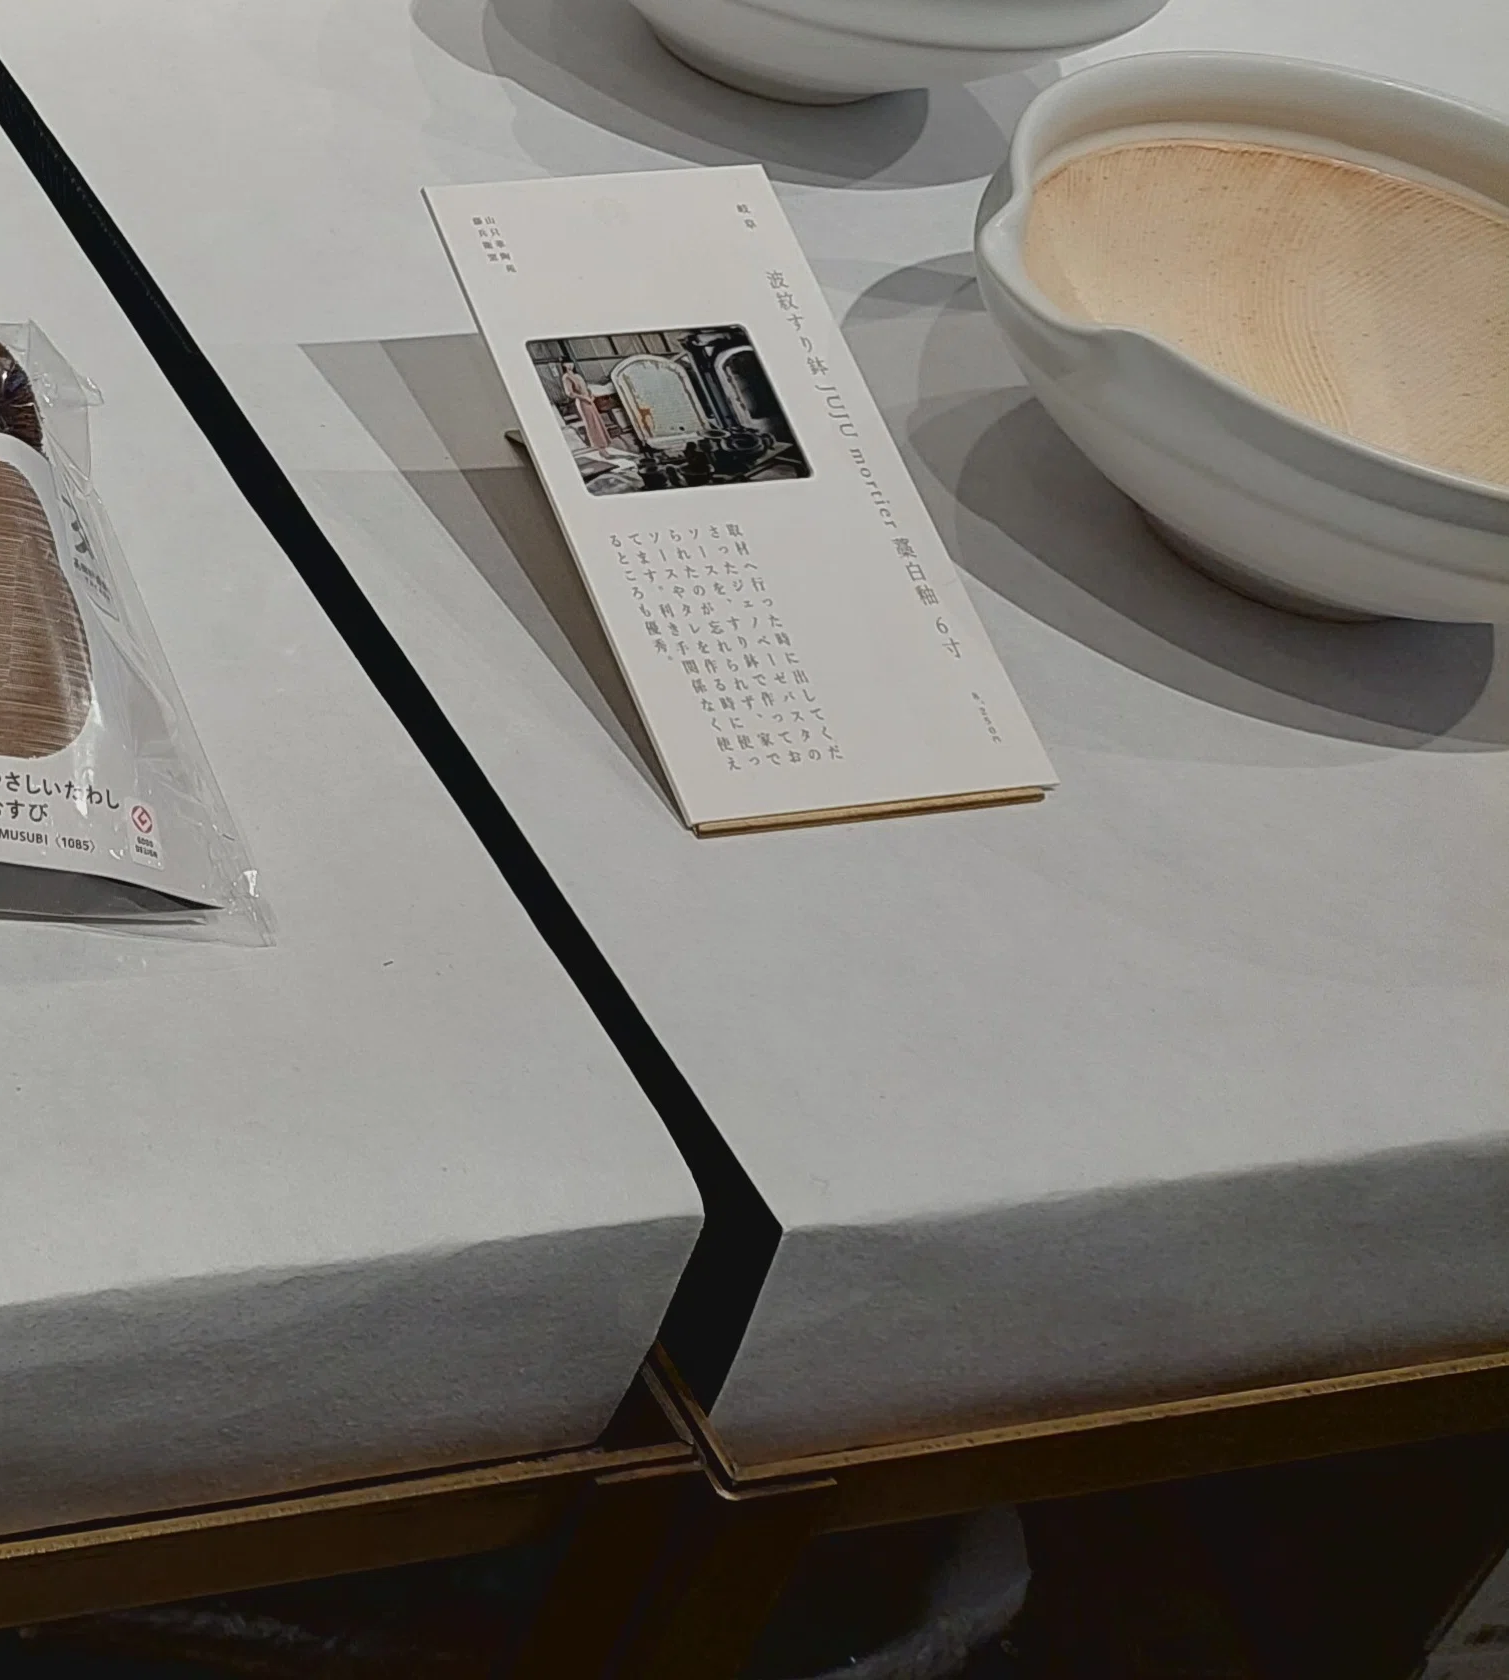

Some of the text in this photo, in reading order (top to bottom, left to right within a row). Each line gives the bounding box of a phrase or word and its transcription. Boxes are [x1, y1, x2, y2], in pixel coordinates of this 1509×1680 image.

[766, 269, 829, 377] 波紋すり鉢
[814, 383, 858, 439] JUJU
[849, 446, 898, 529] mortier
[935, 616, 961, 659] 6寸
